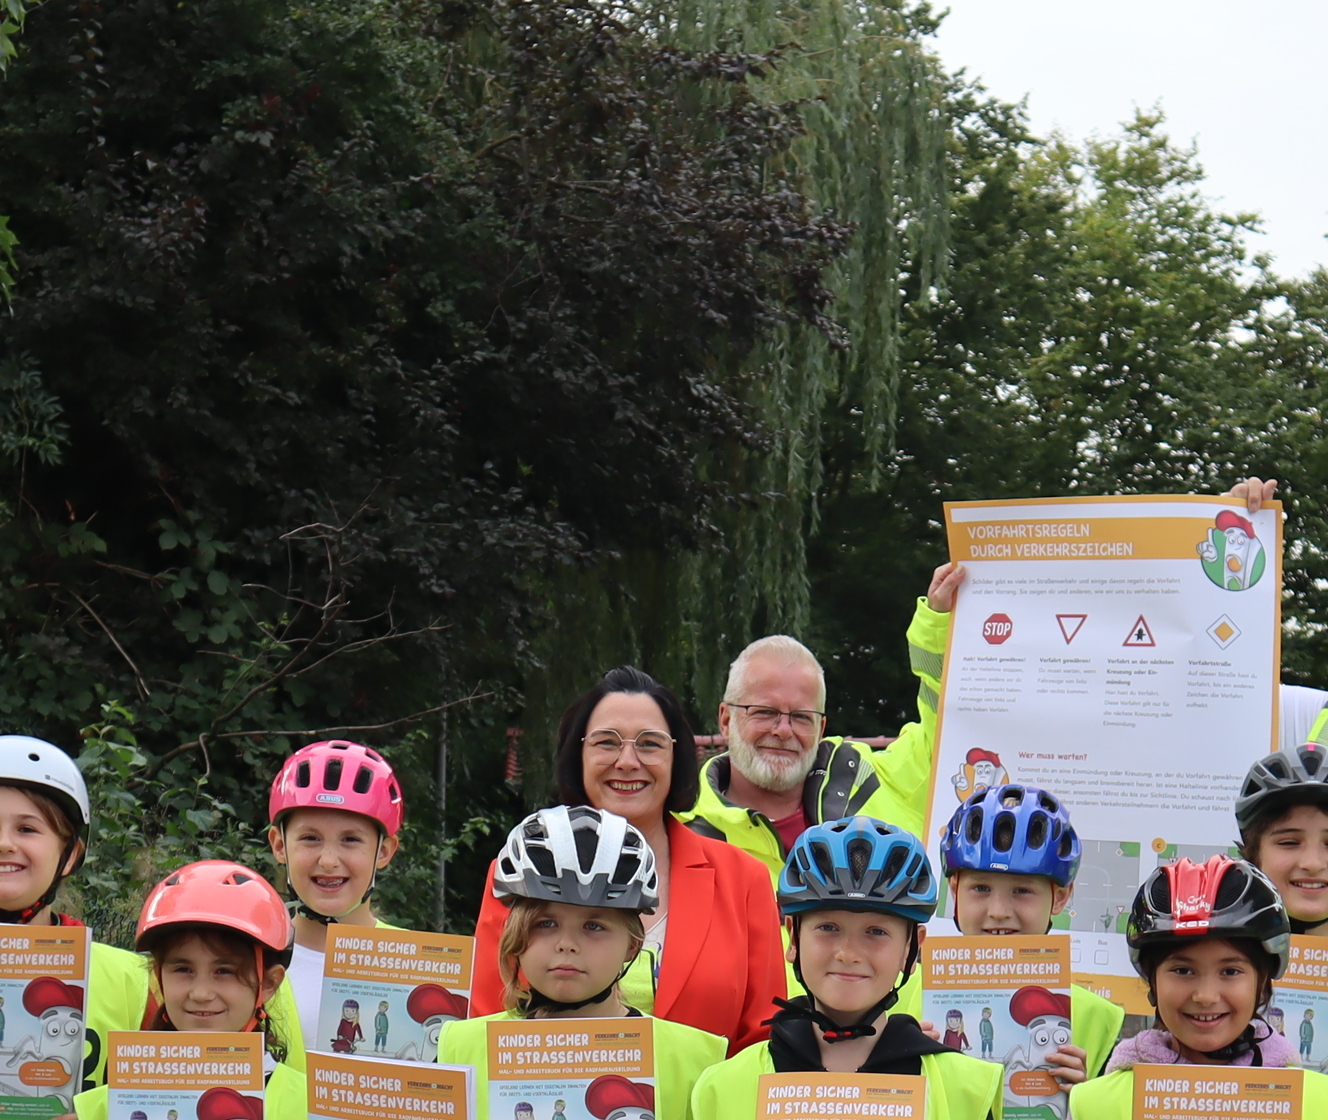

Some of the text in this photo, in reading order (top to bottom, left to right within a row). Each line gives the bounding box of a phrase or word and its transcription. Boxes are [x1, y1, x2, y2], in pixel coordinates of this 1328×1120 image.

[967, 523, 1090, 539] VORFAHRTSREGELN
[969, 542, 1133, 558] DURCH VERKEHRSZEICHEN
[984, 622, 1011, 636] STOP
[1018, 751, 1087, 761] Wer muss warten?
[335, 937, 417, 955] KINDER SICHER
[931, 947, 1014, 961] KINDER SICHER
[333, 951, 461, 975] IM STRASSENVERKEHR
[932, 962, 1061, 976] IM STRASSENVERKEHR
[498, 1033, 589, 1048] KINDER SICHER
[117, 1044, 201, 1059] KINDER SICHER
[498, 1049, 641, 1065] IM STRASSENVERKEHR
[117, 1061, 251, 1075] IM STRASSENVERKEHR
[315, 1067, 402, 1092] KINDER SICHER
[1145, 1078, 1239, 1095] KINDER SICHER
[315, 1085, 455, 1115] IM STRASSENVERKEHR
[767, 1085, 861, 1099] KINDER SICHER
[766, 1101, 913, 1117] IM STRASSENVERKEHR
[1144, 1095, 1291, 1114] IM STRASSENVERKEHR
